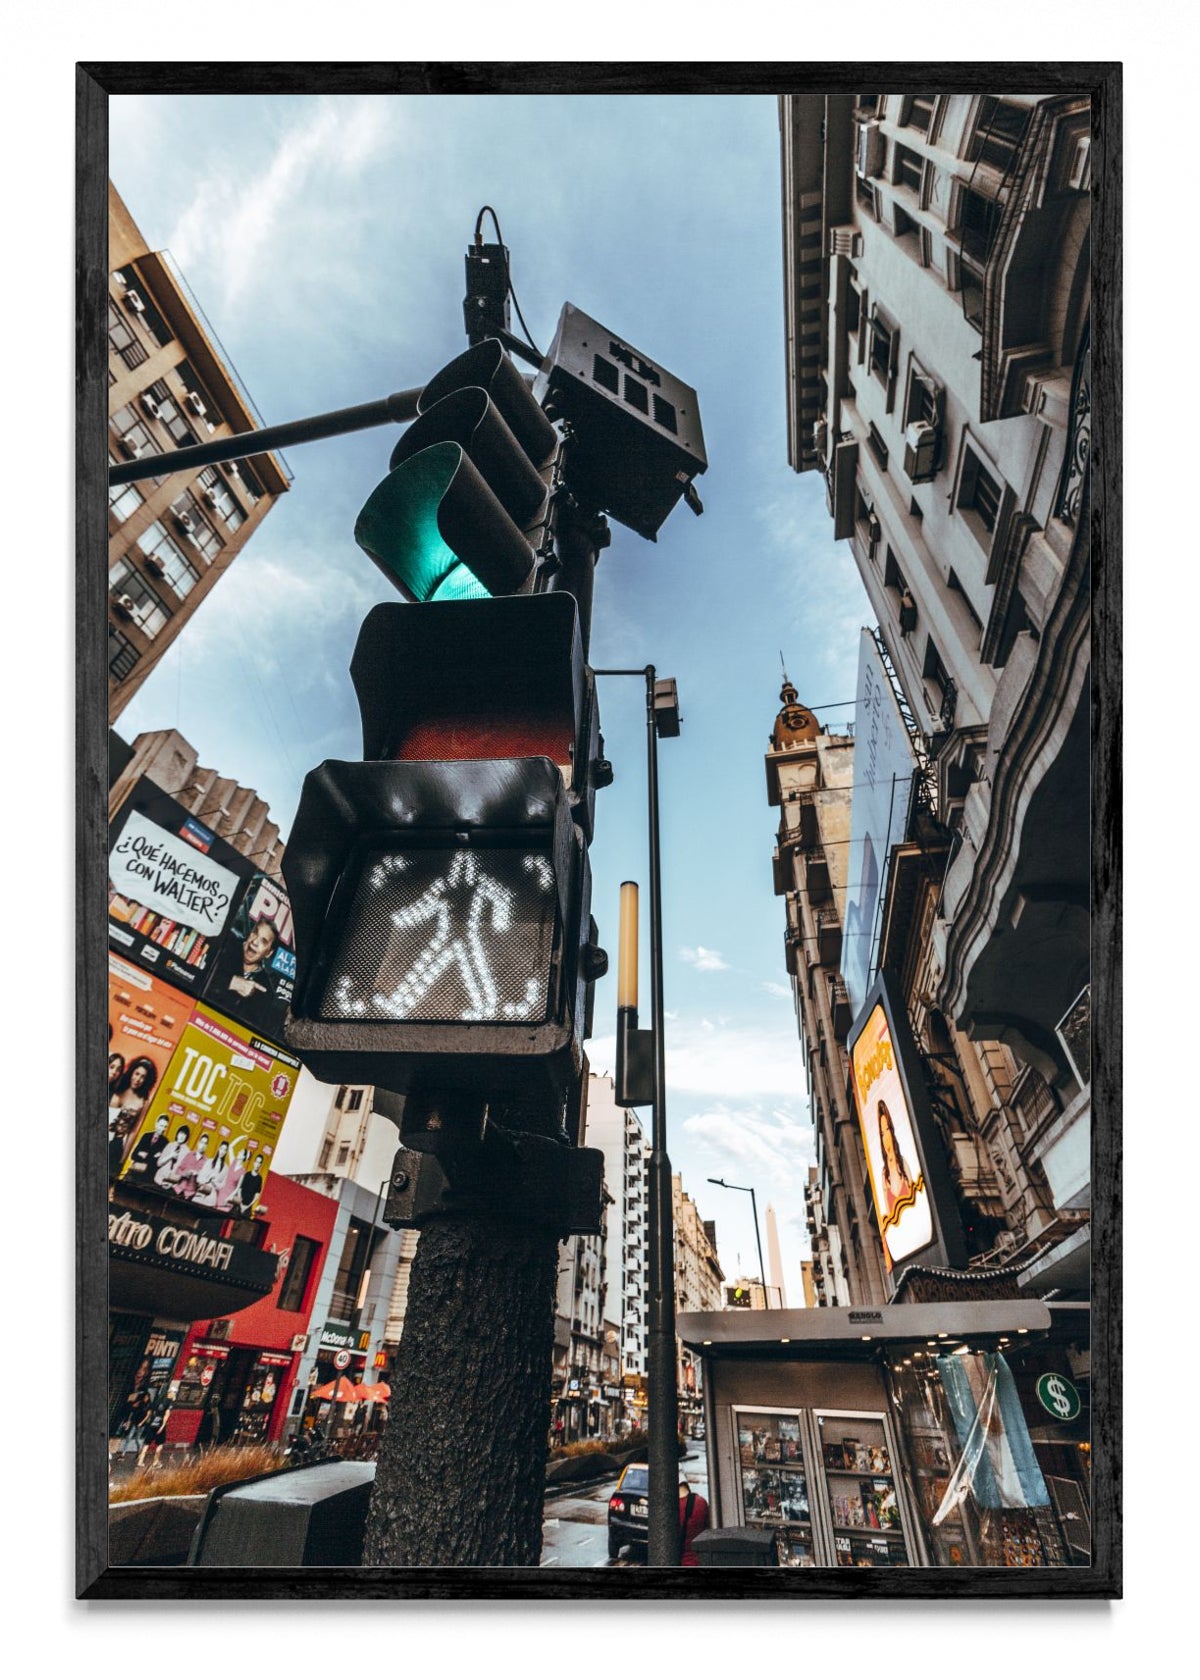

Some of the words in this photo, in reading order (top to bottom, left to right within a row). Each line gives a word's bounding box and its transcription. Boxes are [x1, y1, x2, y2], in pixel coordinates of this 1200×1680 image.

[116, 837, 163, 862] ¿QUÉ
[159, 852, 220, 897] HACEMOS
[126, 859, 154, 881] CON
[153, 871, 229, 923] WALTER?
[174, 1046, 227, 1106] TOC
[217, 1073, 265, 1133] TOC
[156, 1226, 234, 1270] COMAFI
[144, 1339, 180, 1358] PINTI
[338, 1354, 348, 1364] 40
